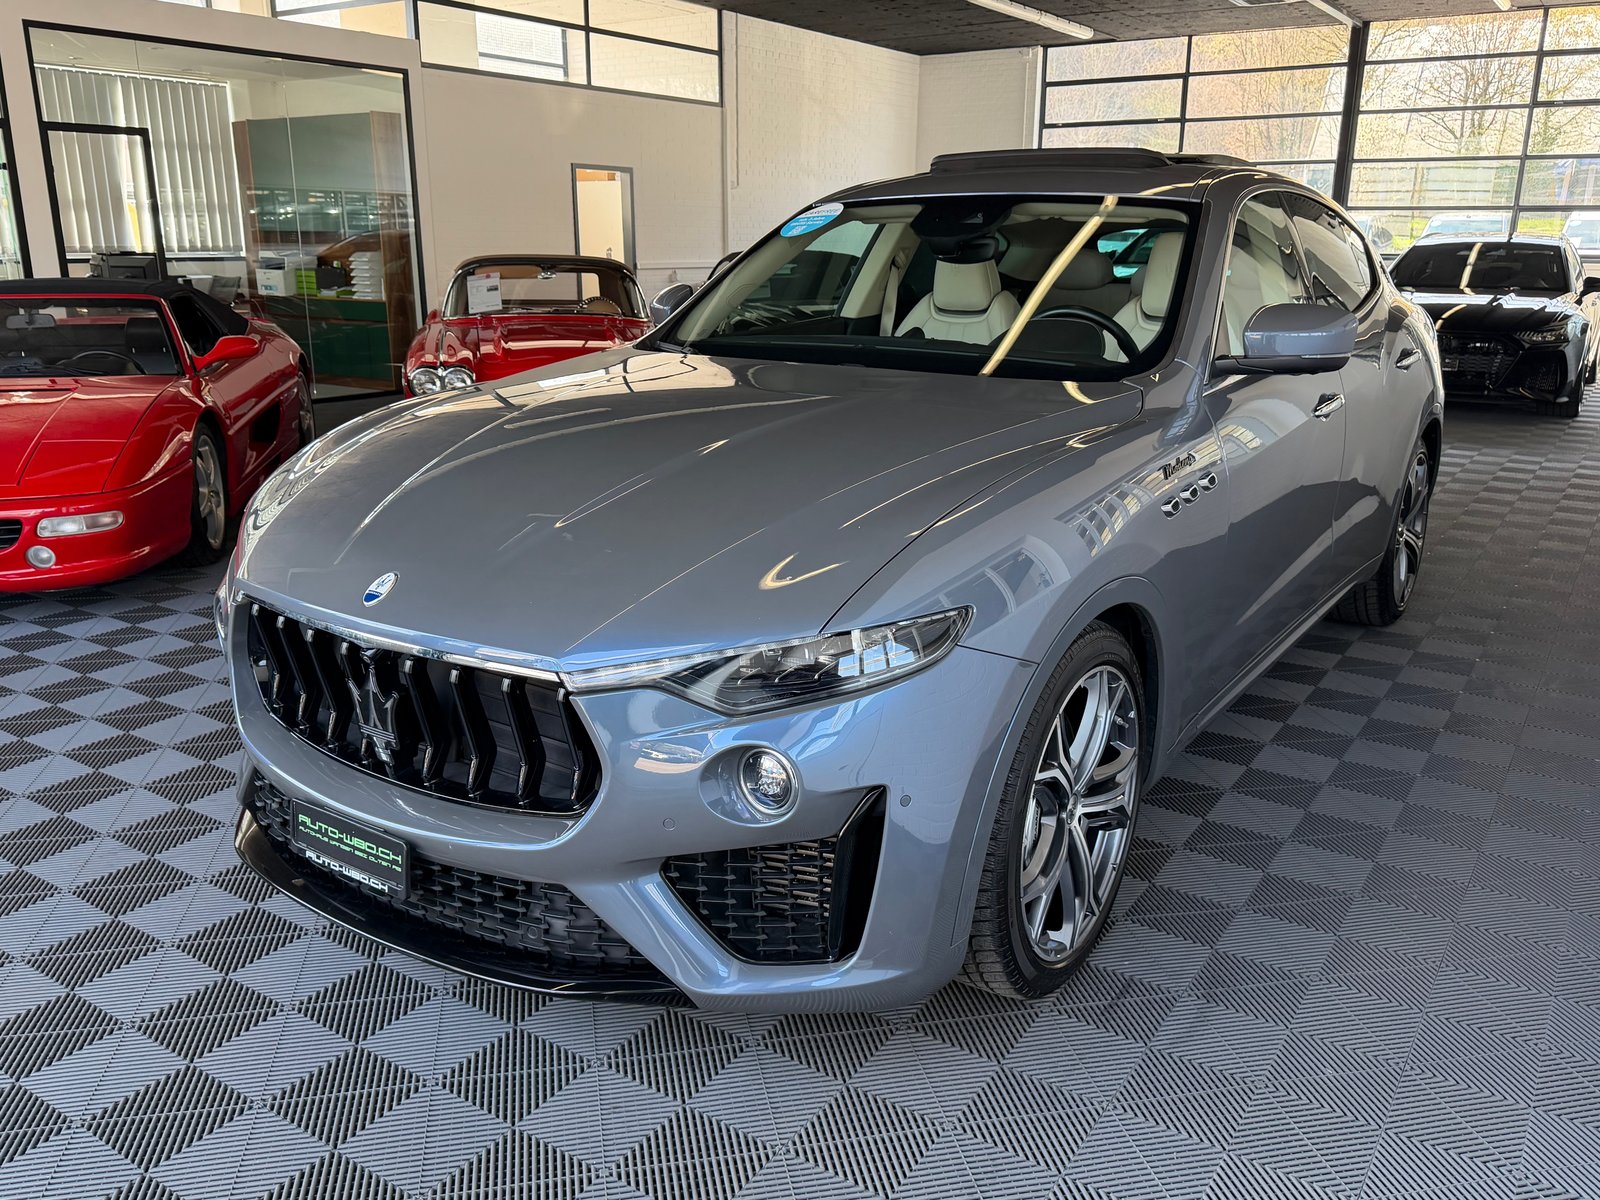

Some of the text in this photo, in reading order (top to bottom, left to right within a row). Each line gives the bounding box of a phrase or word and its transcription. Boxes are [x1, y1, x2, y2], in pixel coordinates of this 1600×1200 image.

[299, 826, 329, 843] AUTOHAUS
[299, 814, 402, 865] AUTO-WBO.CH
[305, 850, 388, 893] AUTO-WBO.CH
